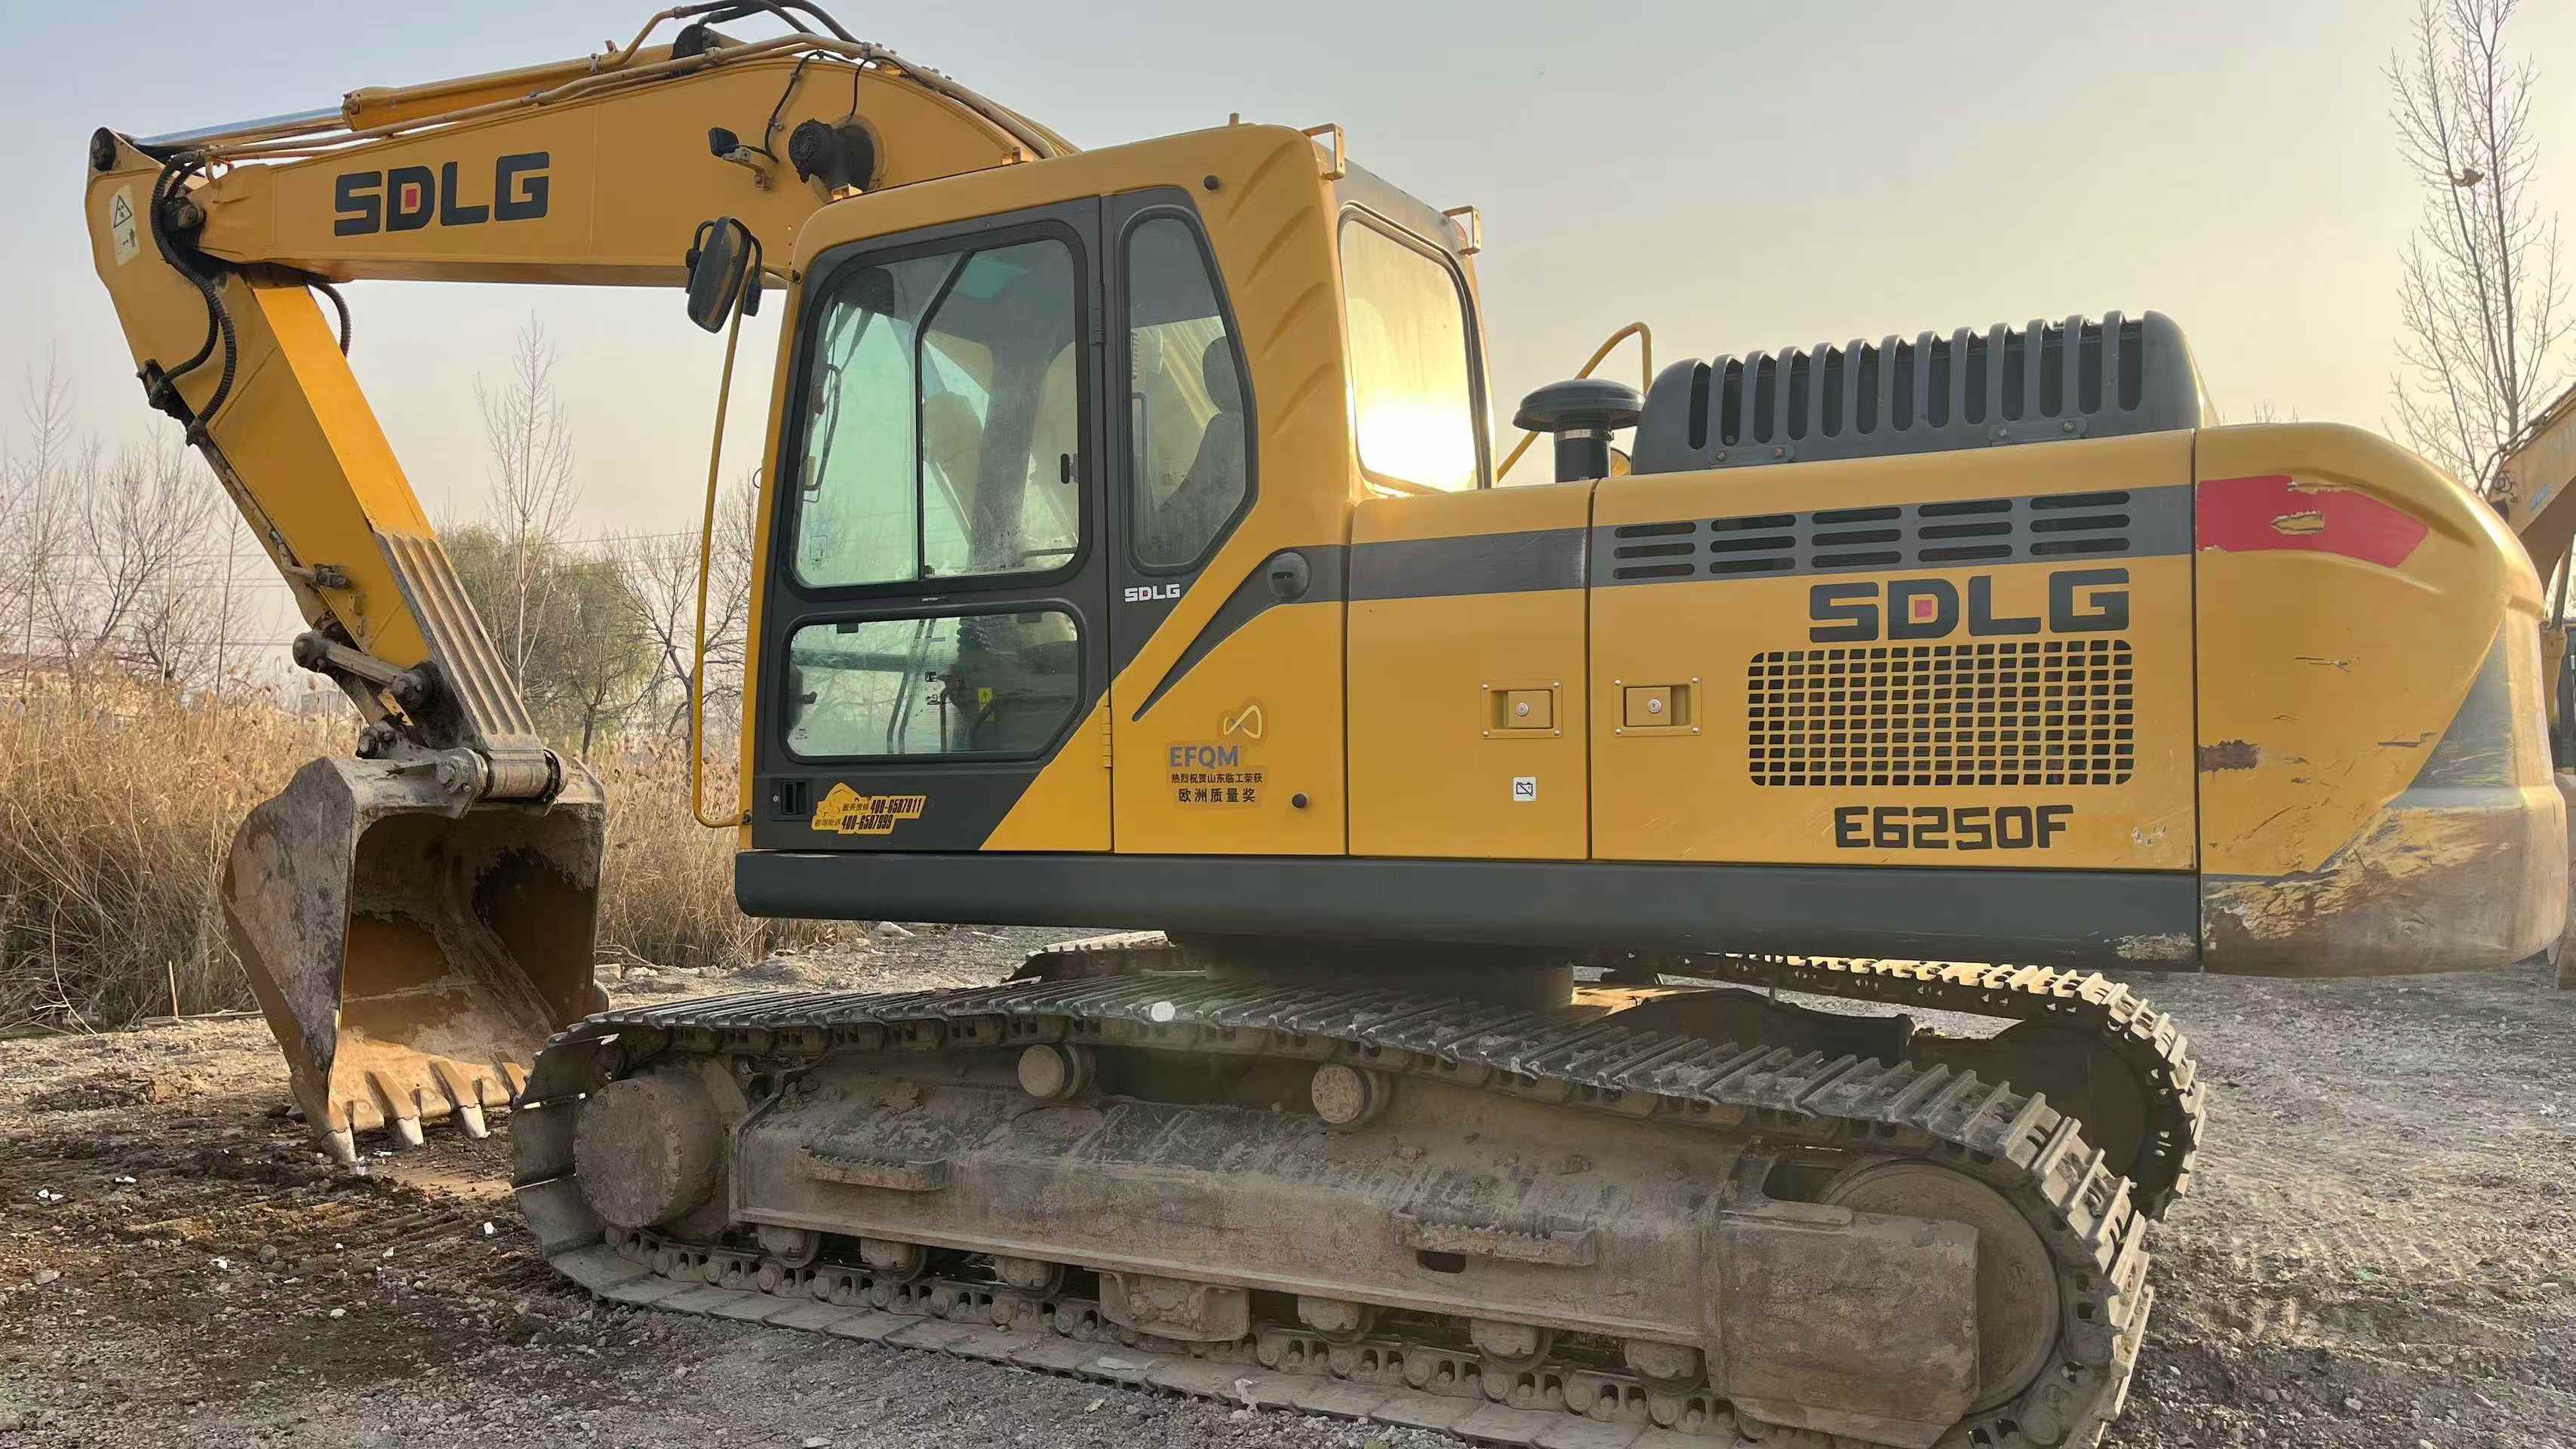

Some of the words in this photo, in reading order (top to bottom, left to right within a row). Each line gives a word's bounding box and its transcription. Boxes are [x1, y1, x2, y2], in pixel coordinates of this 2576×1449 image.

[334, 151, 550, 237] SDLG
[1124, 583, 1181, 603] SDLG
[1809, 567, 2130, 644] SDLG
[1170, 745, 1240, 769] EFQM
[1171, 772, 1263, 784] 热烈祝贺山东临工荣获
[1178, 787, 1256, 803] 欧洲质量奖
[869, 798, 922, 814] 400-6587911
[841, 814, 894, 830] 400-6587999
[1834, 804, 2074, 851] E6250F
